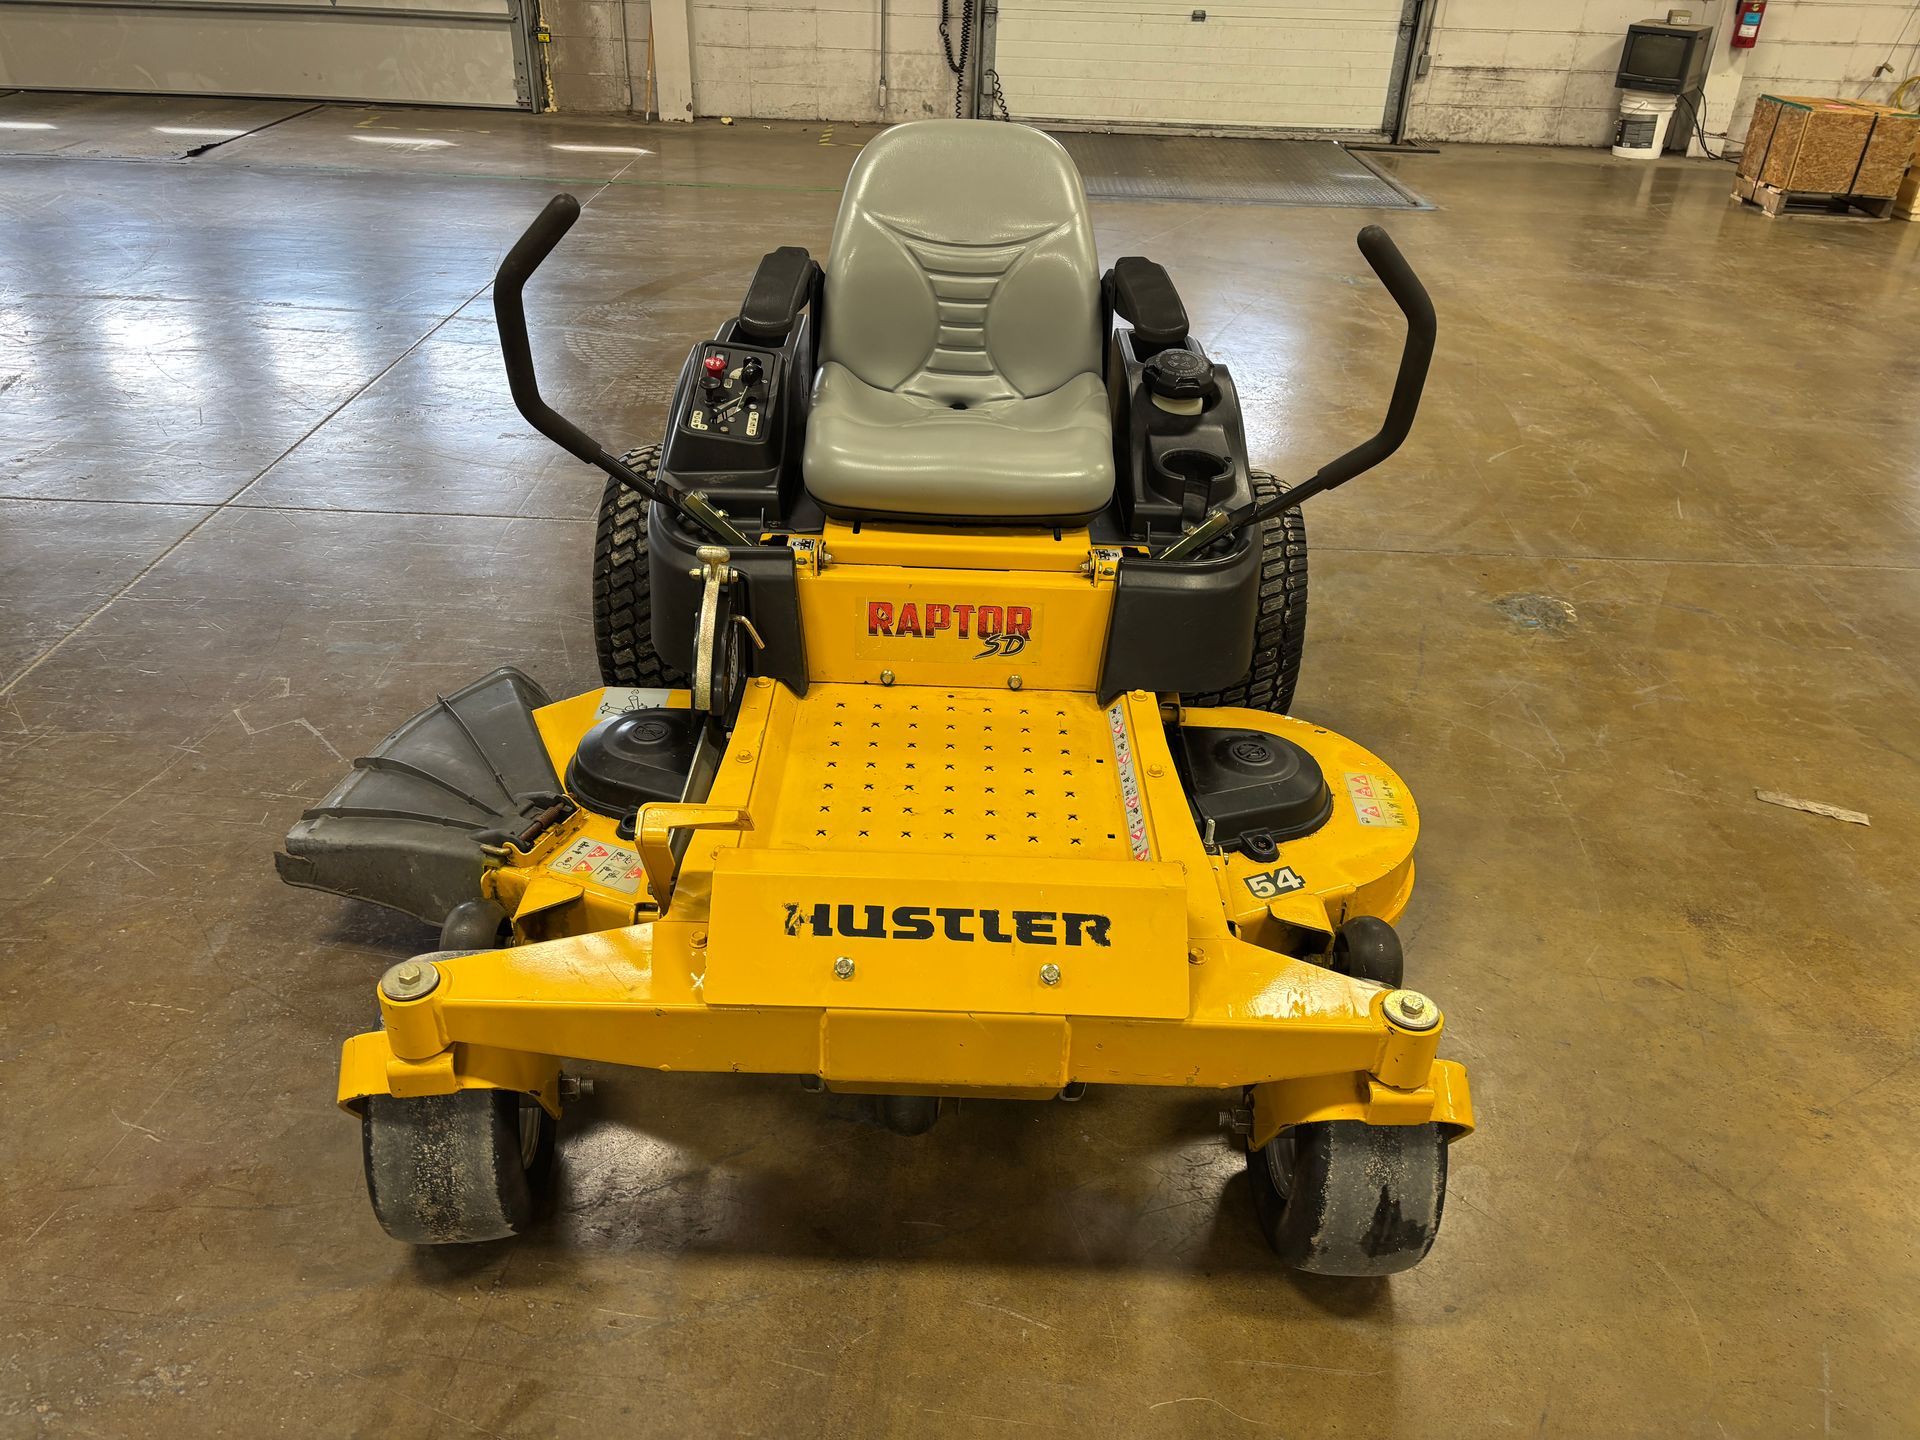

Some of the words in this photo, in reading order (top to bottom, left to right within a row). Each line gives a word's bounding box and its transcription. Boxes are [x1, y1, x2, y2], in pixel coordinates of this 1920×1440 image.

[867, 601, 1032, 641] RAPTOR
[972, 633, 1027, 660] SD
[1246, 867, 1304, 898] 54
[783, 902, 1112, 947] HUSTLER
